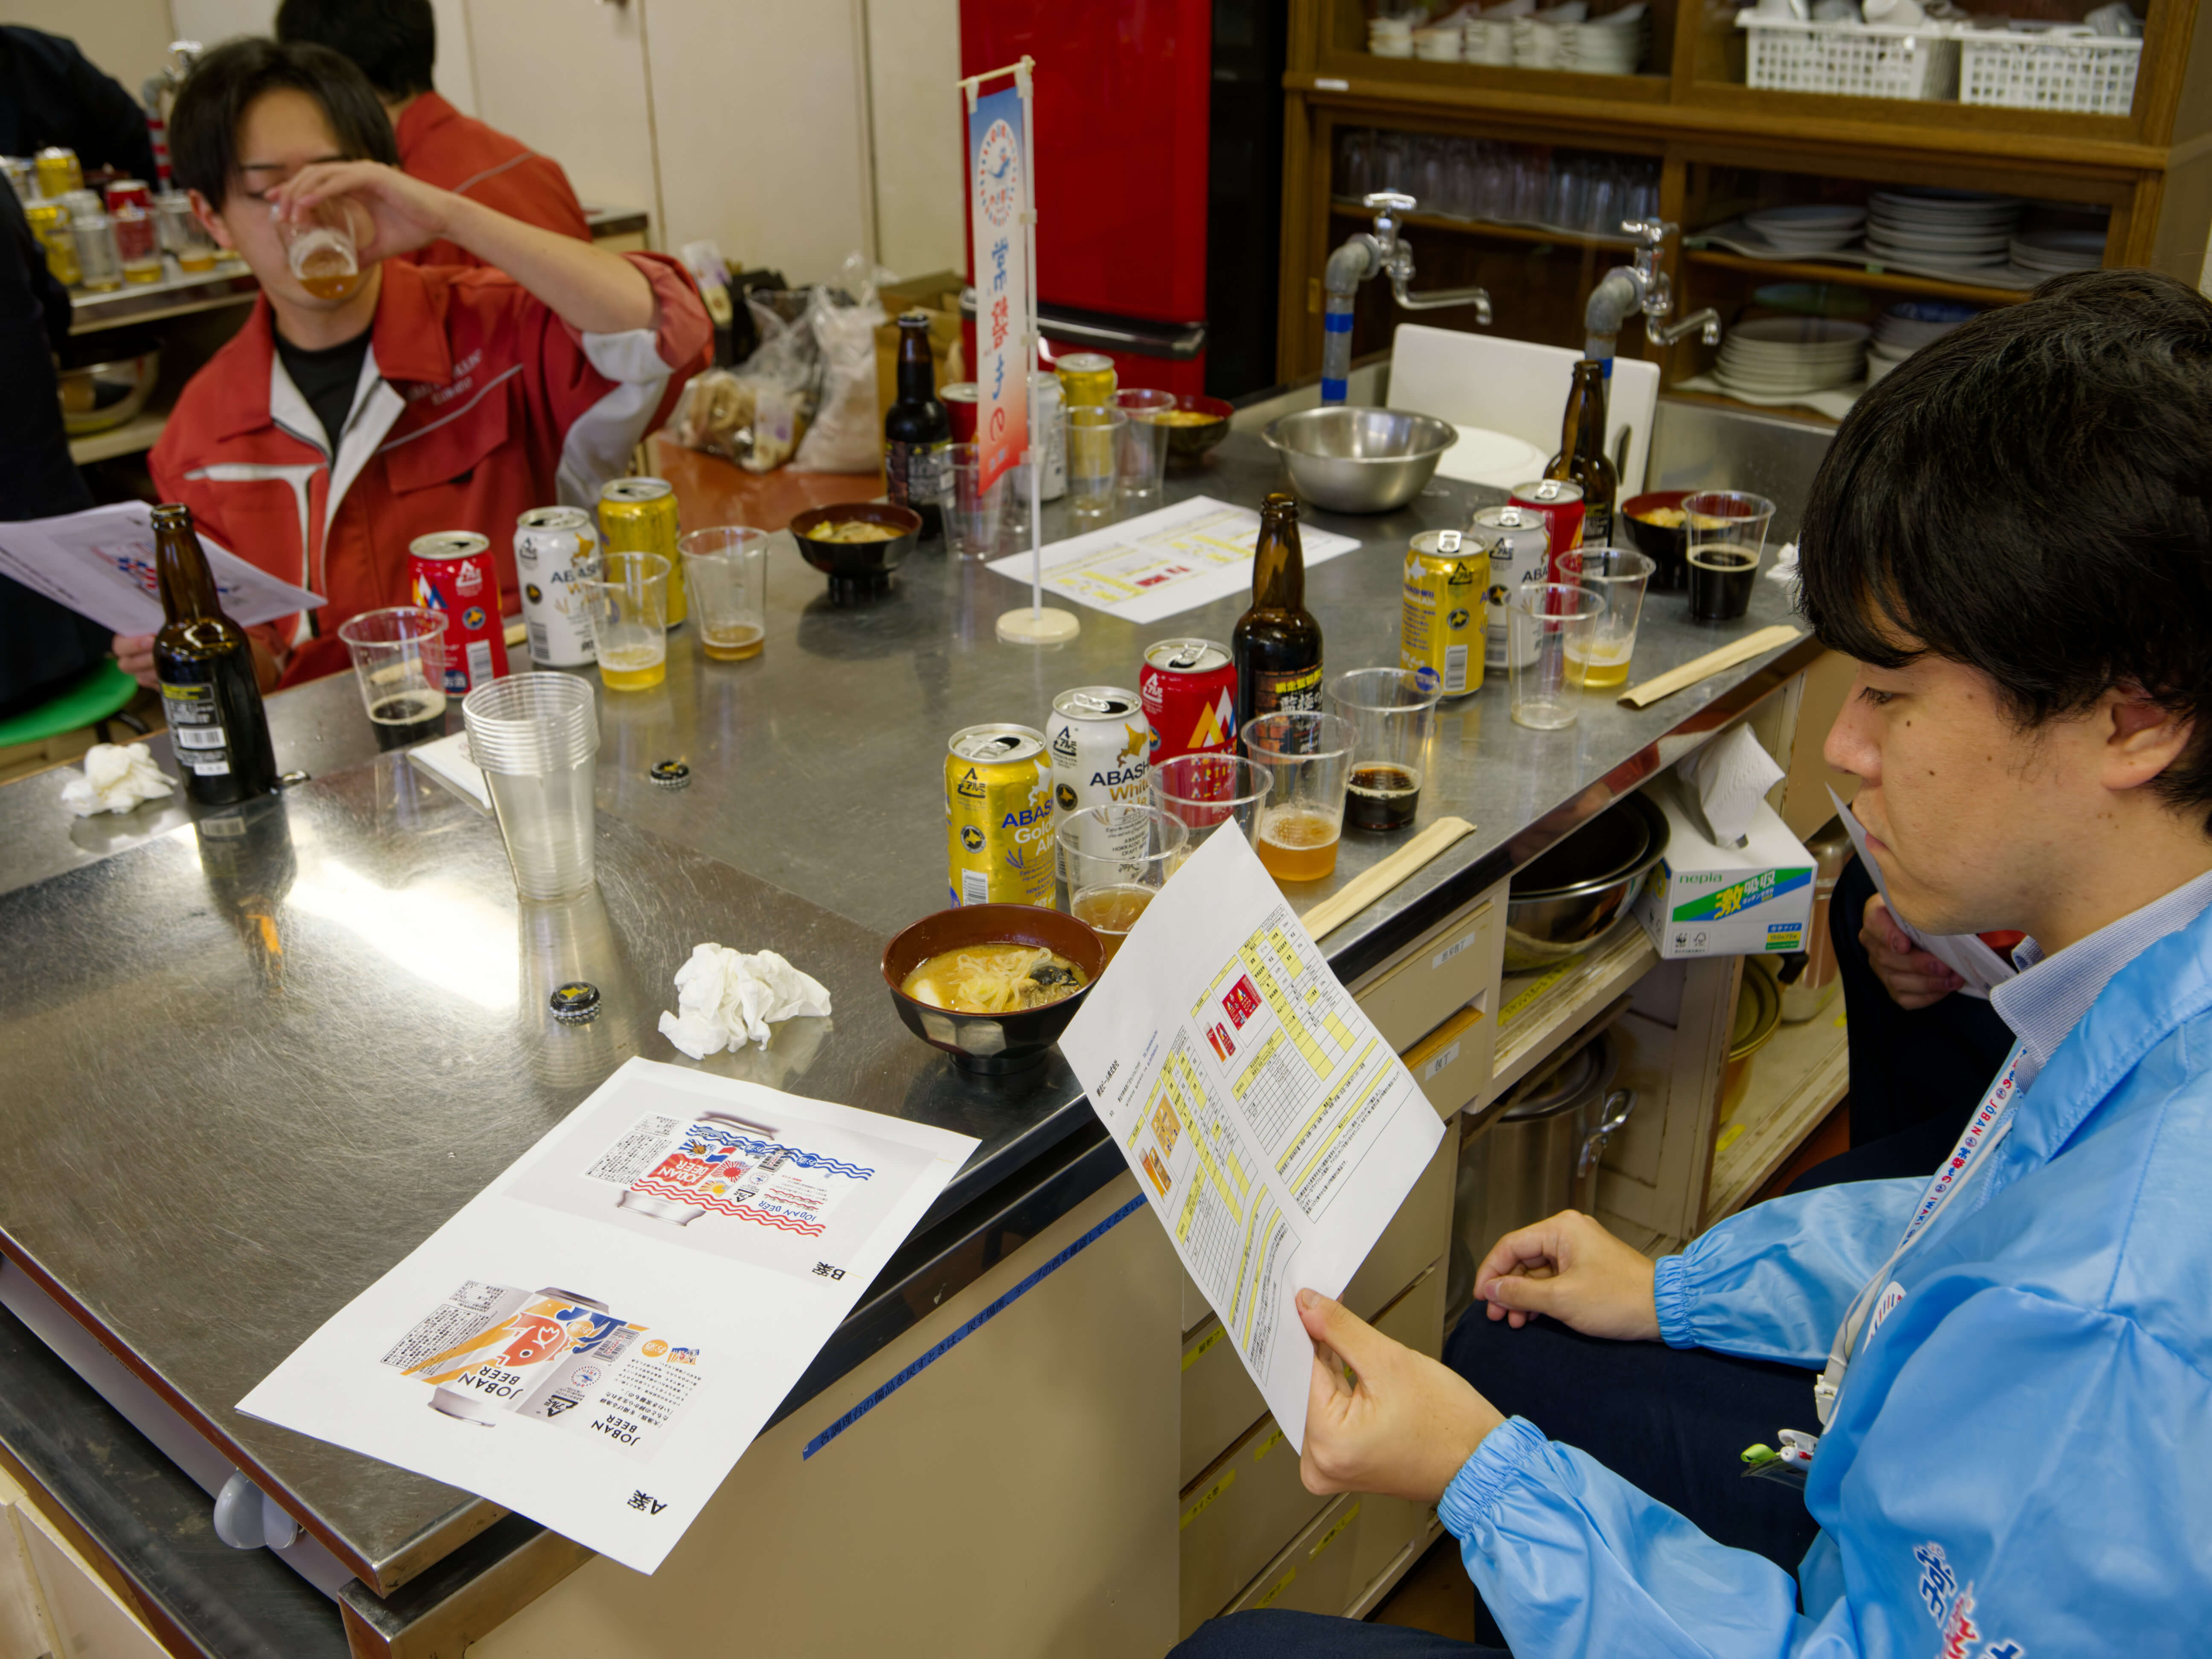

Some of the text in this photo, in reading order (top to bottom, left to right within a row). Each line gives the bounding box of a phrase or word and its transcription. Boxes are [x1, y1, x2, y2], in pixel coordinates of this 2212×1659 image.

[966, 780, 986, 792] アルミ
[1191, 782, 1221, 799] ALE
[1035, 833, 1054, 856] Ale
[1679, 872, 1723, 884] nepia
[1441, 939, 1466, 961] 出刃包丁
[1435, 1051, 1451, 1072] 包丁
[798, 1156, 817, 1166] お酒
[1915, 1196, 1938, 1225] IWAKI
[811, 1260, 845, 1281] B案
[604, 1334, 626, 1357] SAMPLE
[644, 1341, 667, 1354] お酒
[457, 1371, 524, 1400] JOBAN
[479, 1365, 521, 1386] BEER
[543, 1398, 564, 1411] アルミ
[591, 1419, 641, 1447] JOBAN
[606, 1414, 638, 1433] BEER
[627, 1489, 669, 1515] A案
